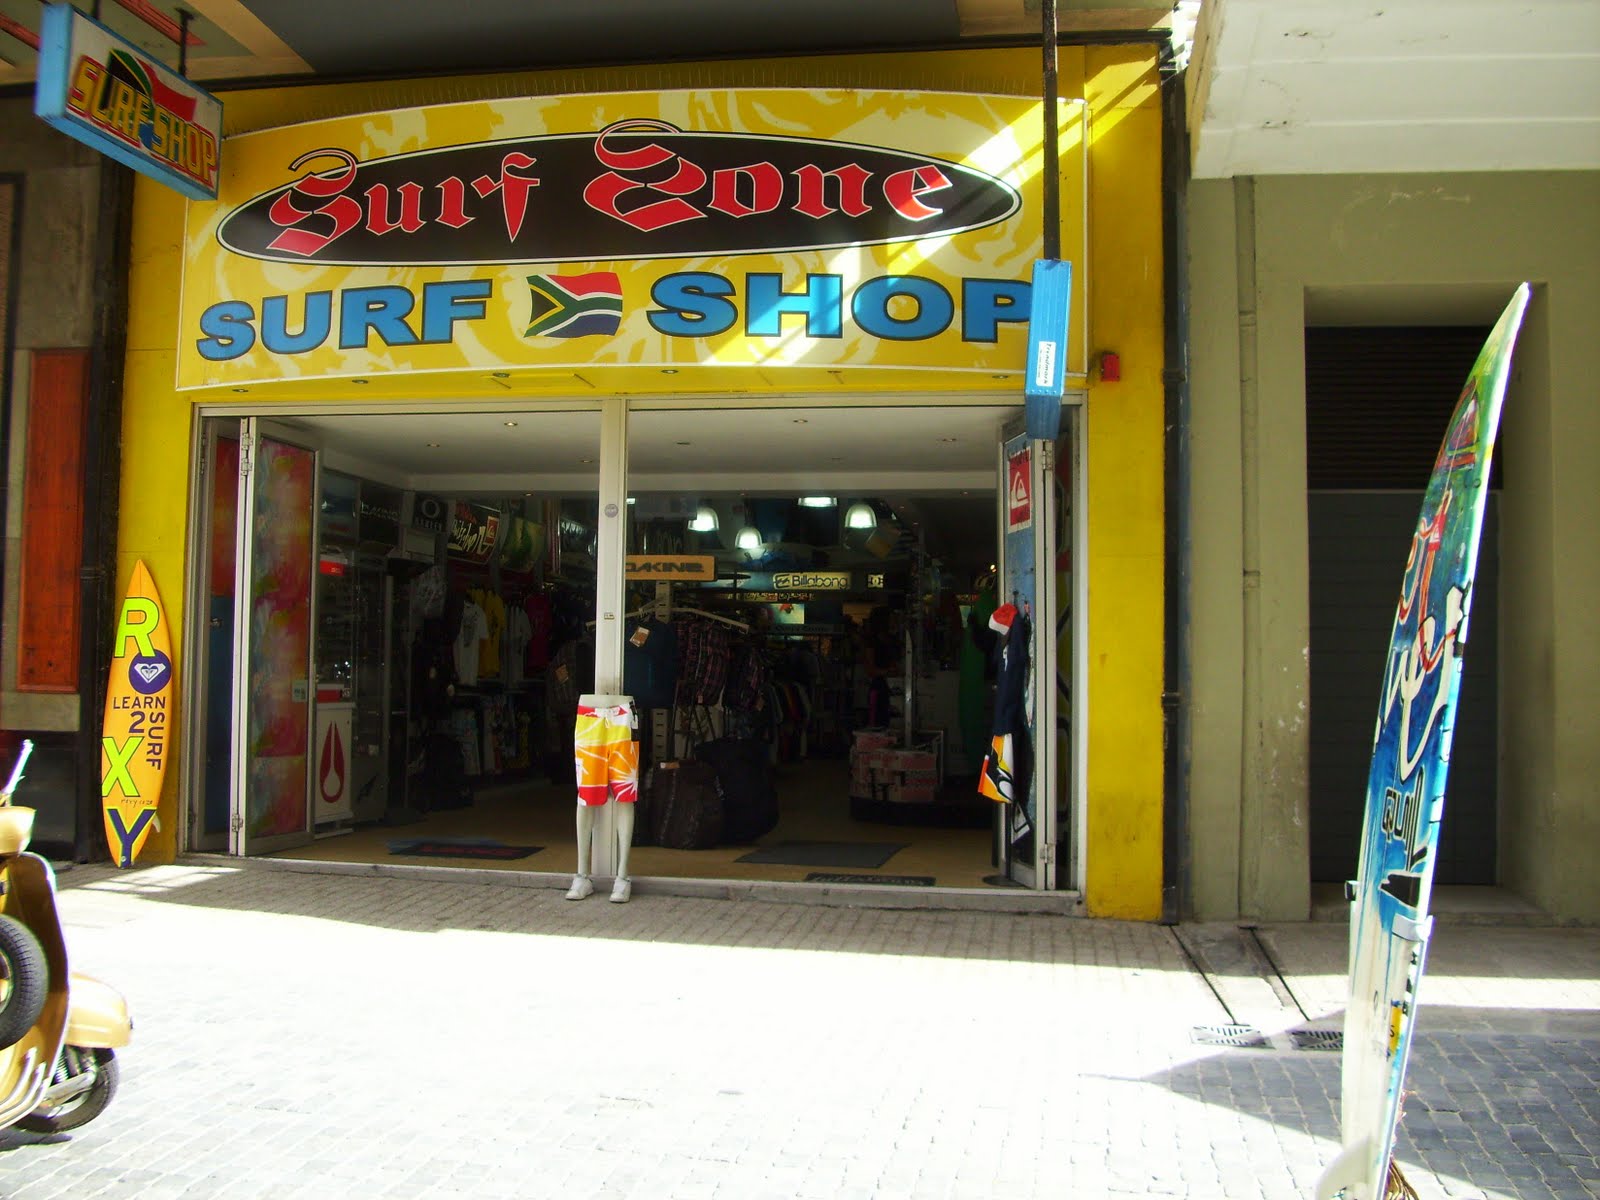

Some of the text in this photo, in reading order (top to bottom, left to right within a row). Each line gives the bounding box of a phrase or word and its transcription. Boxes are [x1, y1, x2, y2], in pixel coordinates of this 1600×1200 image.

[67, 57, 218, 186] SURF SHOP
[266, 118, 953, 258] Surf Zone
[196, 271, 1032, 361] SURF SHOP
[791, 574, 849, 590] Billabong
[113, 695, 166, 710] LEARN
[128, 711, 145, 734] 2
[145, 712, 166, 770] SURF
